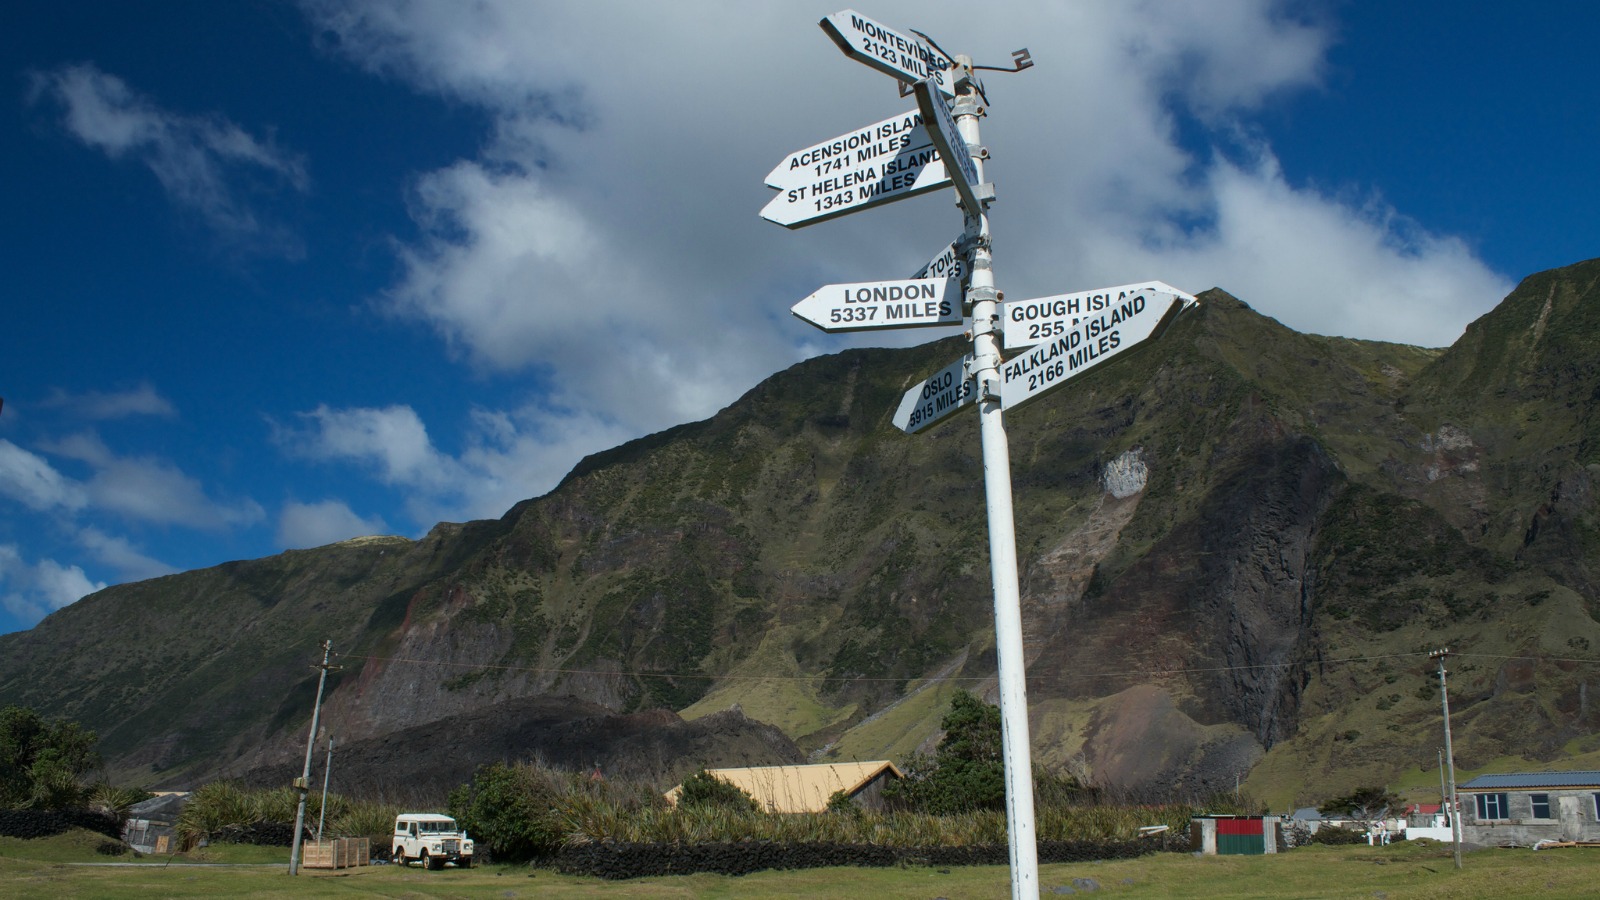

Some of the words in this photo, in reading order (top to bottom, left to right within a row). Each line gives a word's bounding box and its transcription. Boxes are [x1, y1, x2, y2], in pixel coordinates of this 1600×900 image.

[851, 15, 947, 71] MONTEVIDEO
[863, 38, 897, 63] 2123
[901, 54, 944, 85] MILES
[790, 131, 871, 170] ACENSION
[877, 114, 924, 139] ISLAN
[814, 156, 850, 177] 1741
[857, 134, 911, 163] MILES
[787, 187, 807, 203] ST
[812, 167, 876, 197] HELENA
[882, 149, 941, 177] ISLAND
[814, 191, 853, 212] 1343
[859, 173, 915, 199] MILES
[831, 307, 878, 323] 5337
[886, 301, 952, 319] MILES
[845, 284, 935, 303] LONDON
[1012, 298, 1080, 322] GOUGH
[1005, 331, 1080, 383] FALKLAND
[1085, 295, 1146, 340] ISLAND
[1029, 321, 1064, 339] 255
[1028, 361, 1064, 391] 2166
[1069, 330, 1121, 370] MILES
[910, 402, 933, 427] 5915
[936, 381, 970, 412] MILES
[923, 372, 952, 400] OSLO
